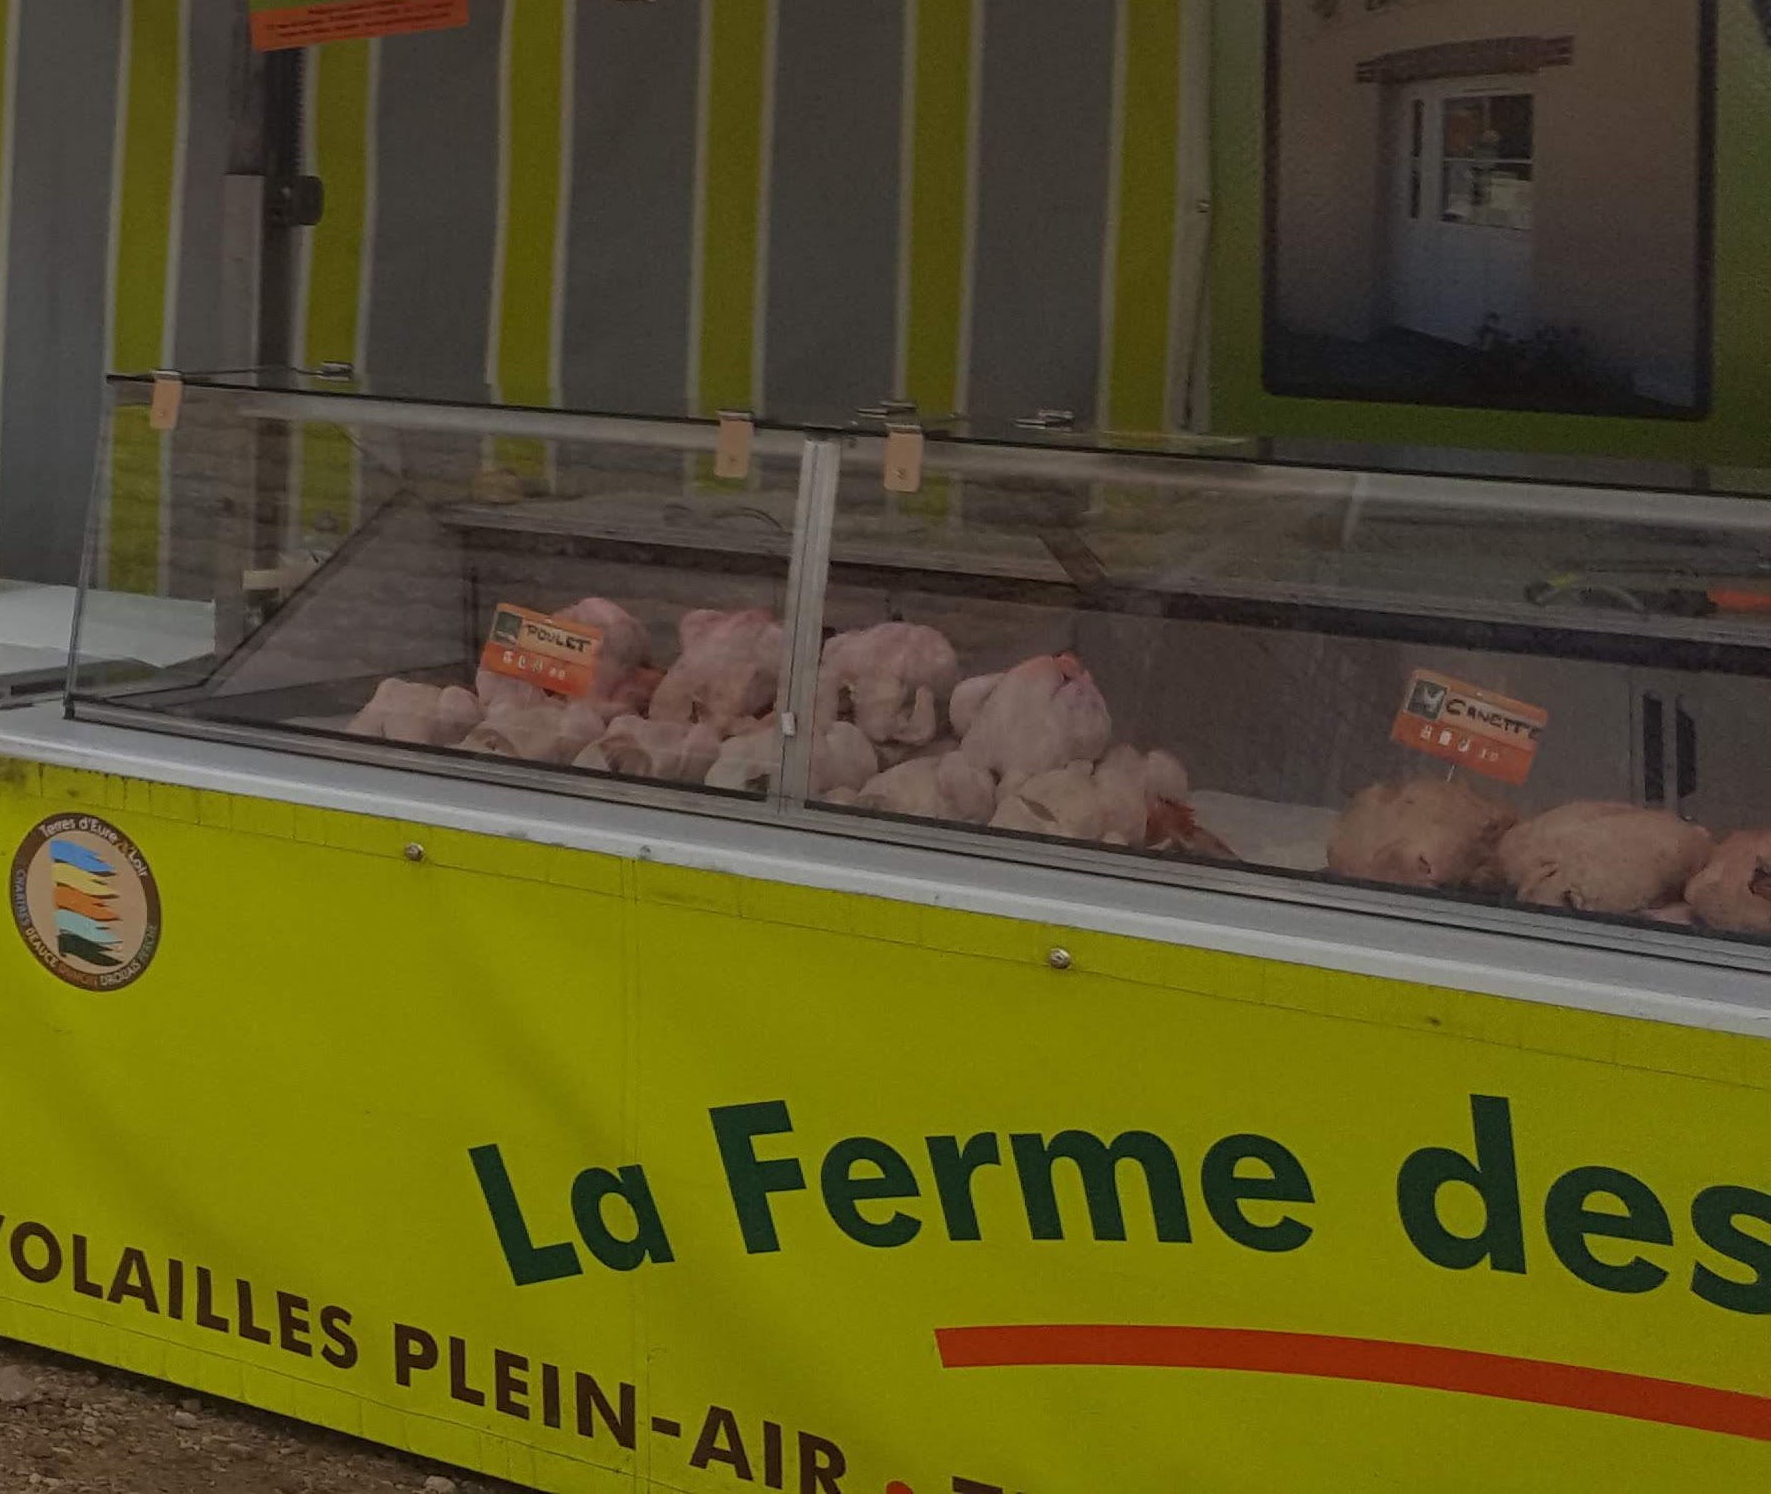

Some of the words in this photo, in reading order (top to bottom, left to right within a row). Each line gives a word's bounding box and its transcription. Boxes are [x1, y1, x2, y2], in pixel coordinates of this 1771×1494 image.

[523, 623, 592, 653] POULET
[1445, 697, 1545, 741] CANETTE
[39, 817, 76, 838] Terres
[468, 1142, 672, 1288] La
[707, 1098, 1318, 1255] Ferme
[1395, 1093, 1771, 1316] des
[392, 1320, 849, 1494] PLEIN-AIR
